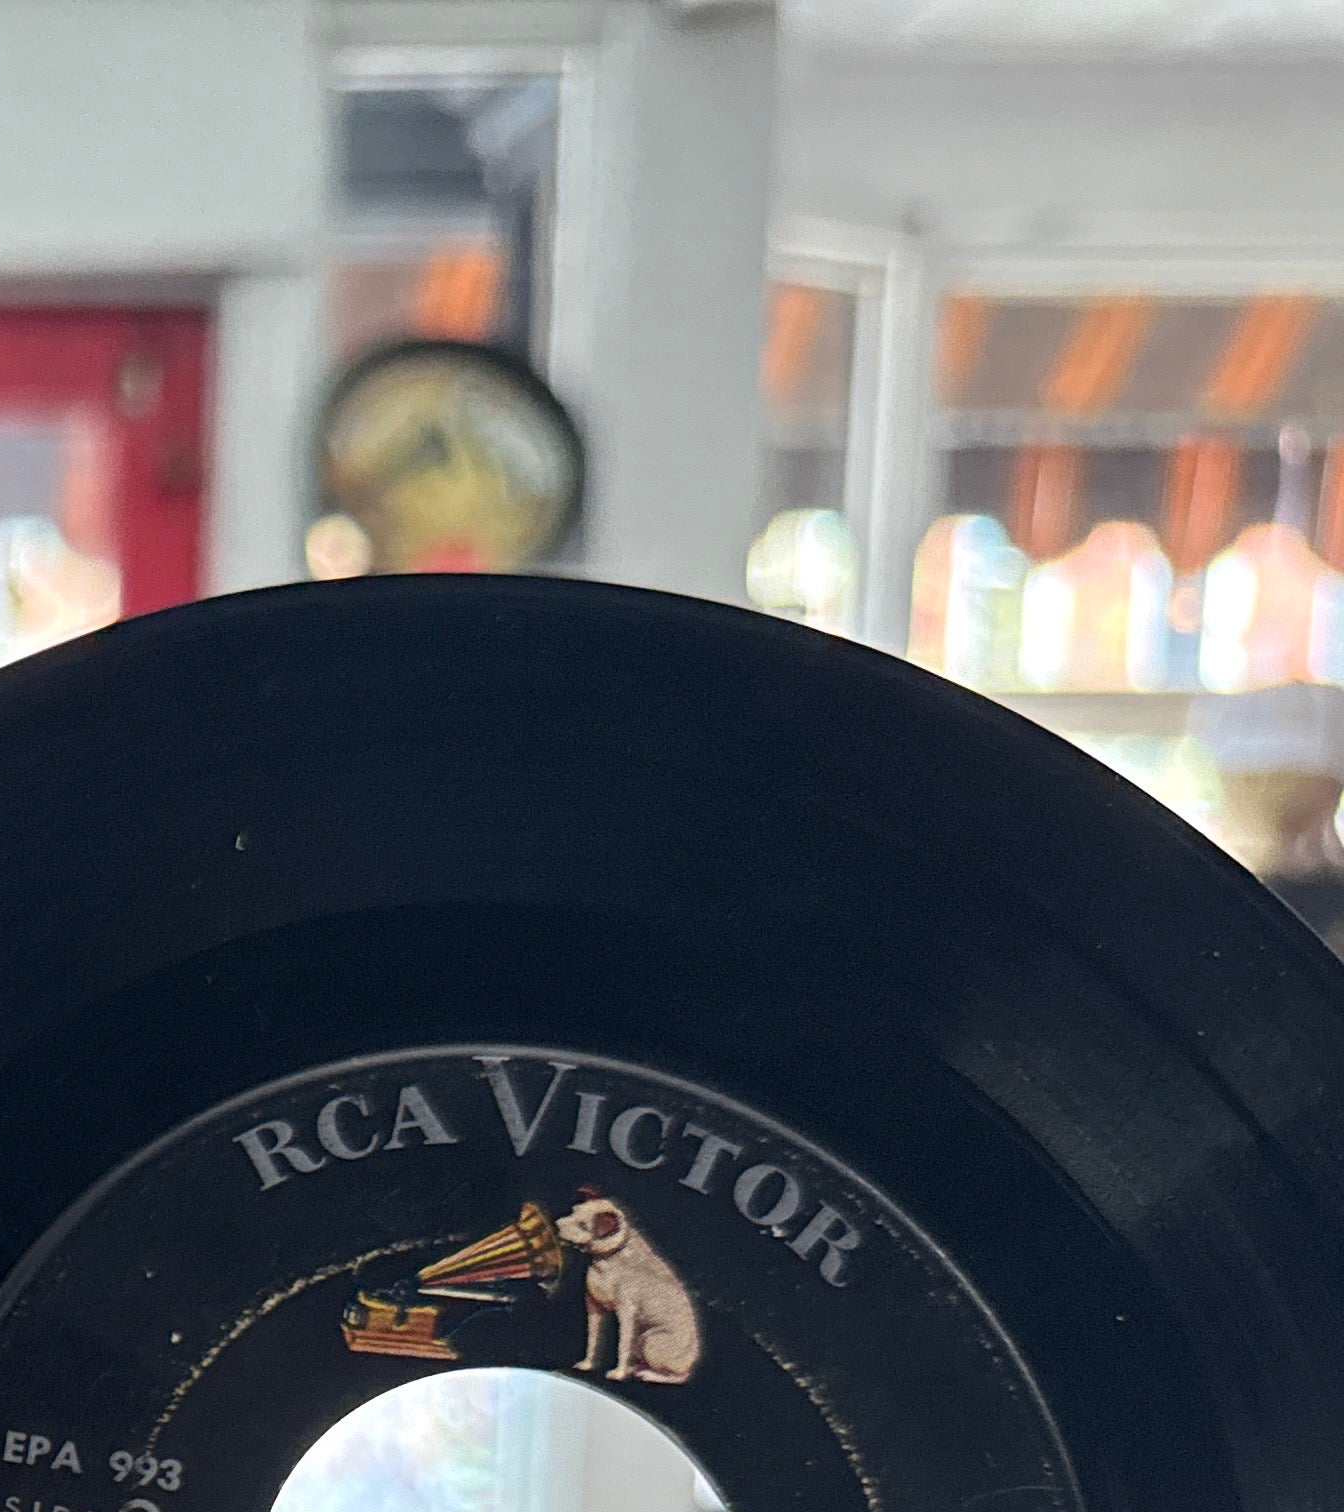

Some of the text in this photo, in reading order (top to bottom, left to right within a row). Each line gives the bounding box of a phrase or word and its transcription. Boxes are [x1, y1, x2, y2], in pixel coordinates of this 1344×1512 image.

[232, 1085, 462, 1192] RCA
[2, 1430, 183, 1492] EPA 993
